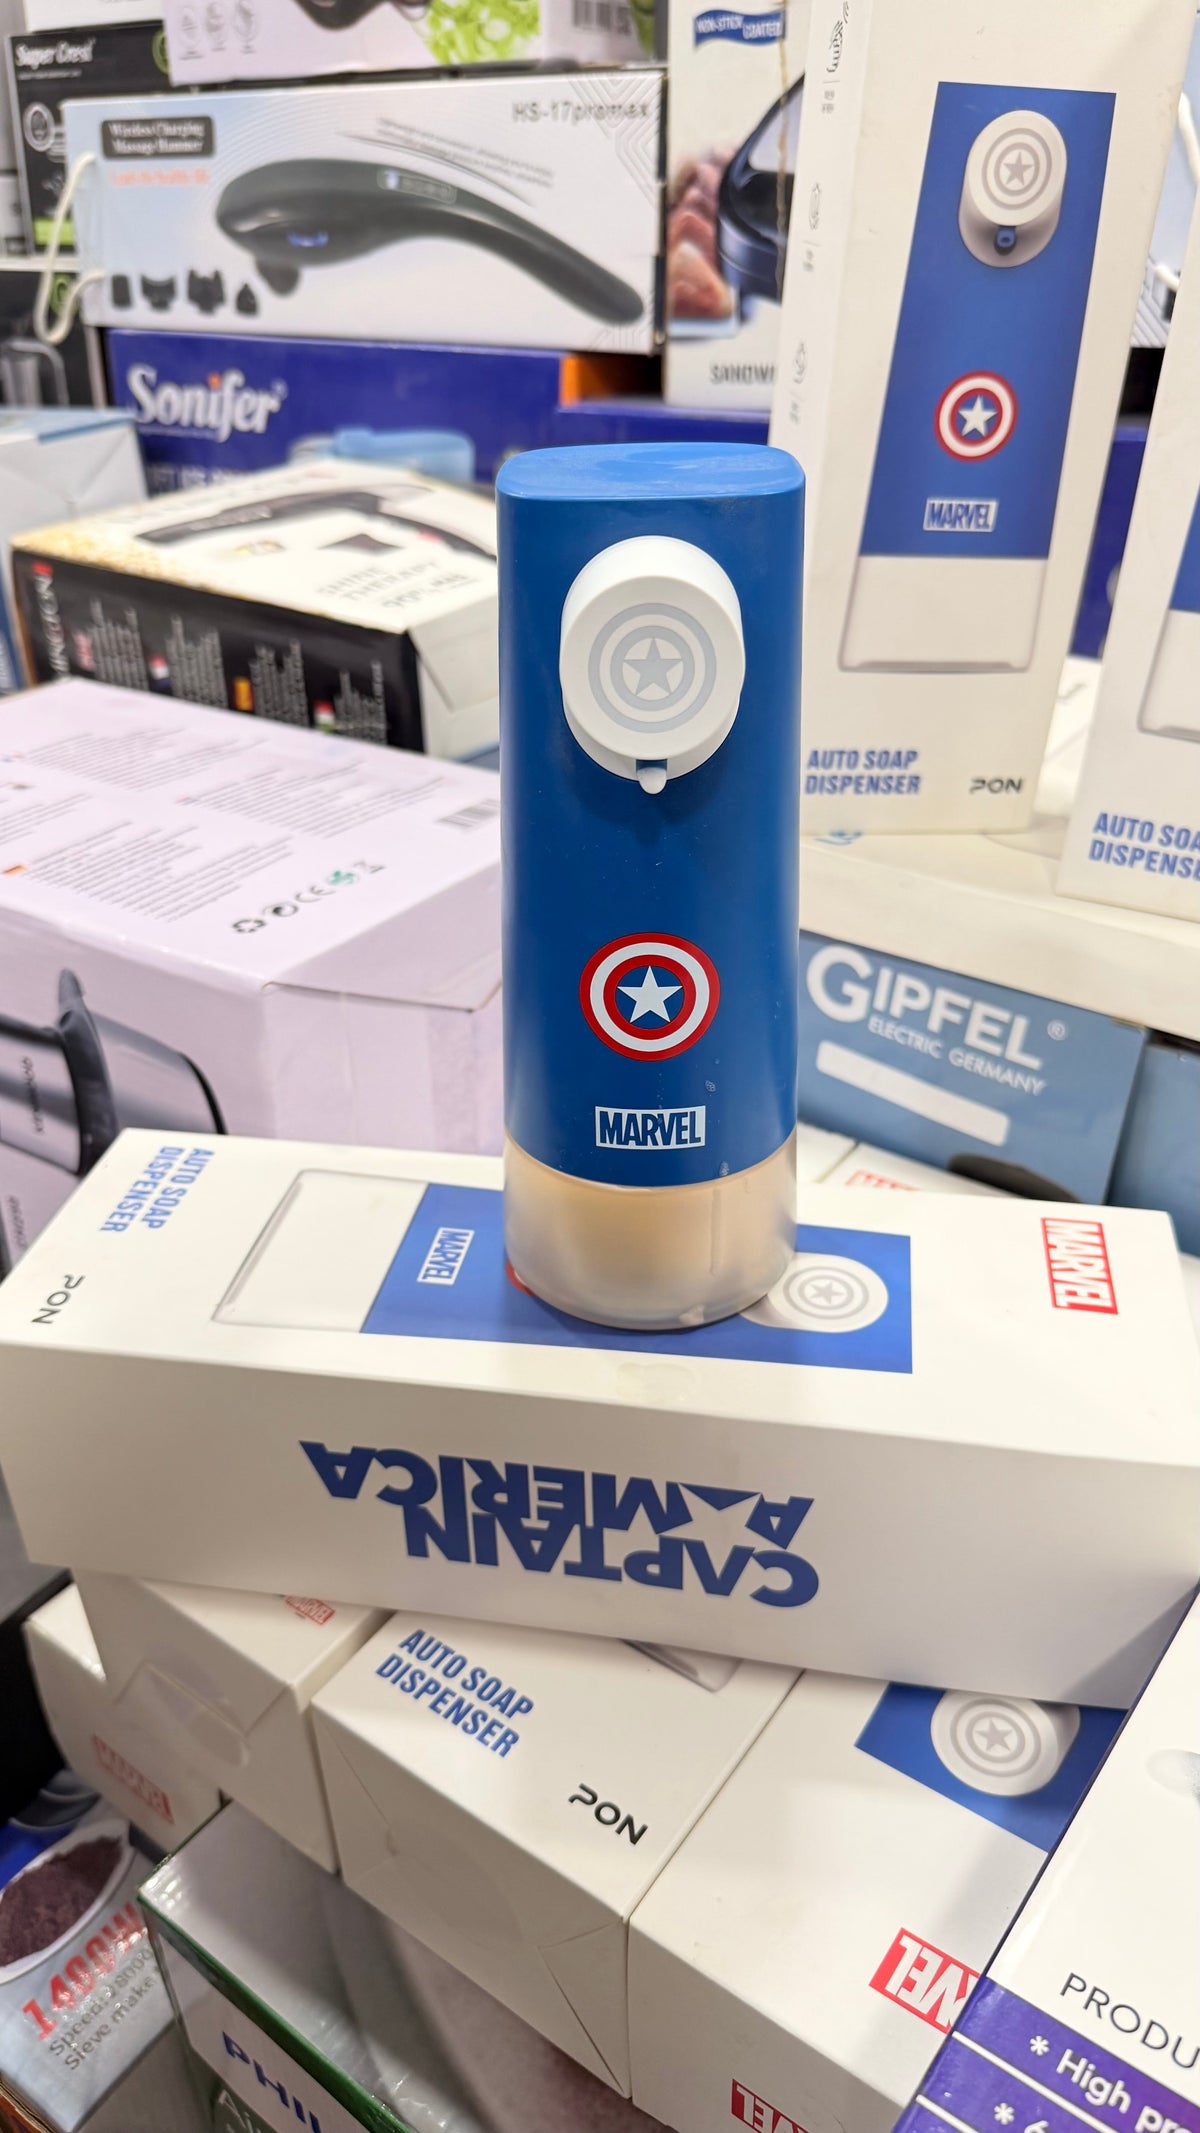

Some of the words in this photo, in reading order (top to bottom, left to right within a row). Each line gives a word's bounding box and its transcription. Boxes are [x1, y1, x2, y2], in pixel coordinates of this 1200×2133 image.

[127, 362, 282, 442] Sonifer
[924, 499, 997, 531] MARVEL
[805, 774, 921, 795] DISPENSER
[807, 750, 859, 770] AUTO
[863, 750, 918, 770] SOAP
[969, 777, 1023, 795] PON
[1092, 812, 1154, 843] AUTO
[806, 944, 1043, 1071] GIPFEL
[867, 1014, 944, 1060] ELECTRIC
[948, 1046, 1046, 1097] GERMANY
[177, 1147, 214, 1186] AUTO
[597, 1108, 704, 1148] MARVEL
[99, 1145, 186, 1234] DISPENSER
[142, 1184, 188, 1231] SOAP
[417, 1228, 474, 1286] MARVEL
[1042, 1218, 1117, 1315] MARVEL
[298, 1440, 815, 1551] AMERICA
[403, 1500, 820, 1609] CAPTAIN
[374, 1652, 521, 1758] DISPENSER
[397, 1628, 469, 1680] AUTO
[460, 1665, 535, 1721] SOAP
[22, 1901, 147, 2041] 1400W
[63, 2016, 113, 2071] Sieve
[111, 1977, 157, 2025] make
[1059, 1972, 1200, 2069] PRODU
[1055, 2047, 1132, 2115] High
